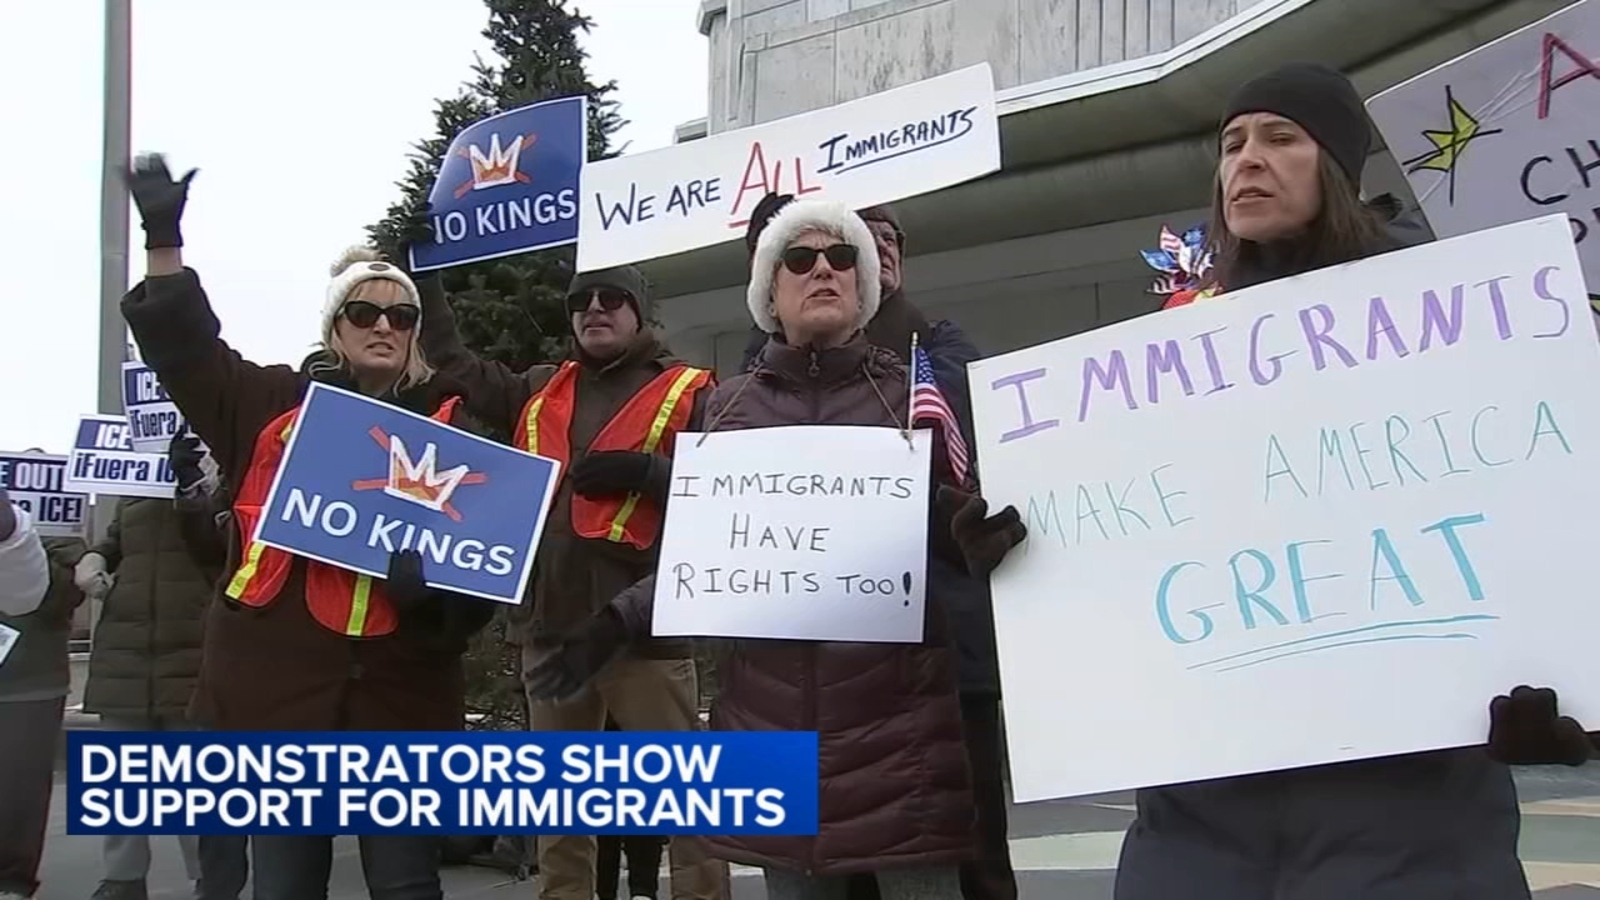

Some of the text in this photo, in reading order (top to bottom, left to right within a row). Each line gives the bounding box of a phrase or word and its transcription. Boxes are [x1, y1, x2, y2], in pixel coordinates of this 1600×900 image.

[595, 182, 656, 231] WE
[665, 177, 721, 217] ARE
[816, 105, 978, 174] IMMIGRANTS
[475, 188, 577, 237] KINGS
[992, 265, 1569, 444] IMMIGRANTS
[15, 461, 61, 491] OUT
[671, 472, 915, 500] IMMIGRANTS
[1022, 399, 1573, 557] MAKE AMERICA
[281, 487, 516, 577] NO KINGS
[729, 512, 831, 552] HAVE
[672, 561, 912, 607] RIGHTS TOO!
[1153, 512, 1486, 645] GREAT
